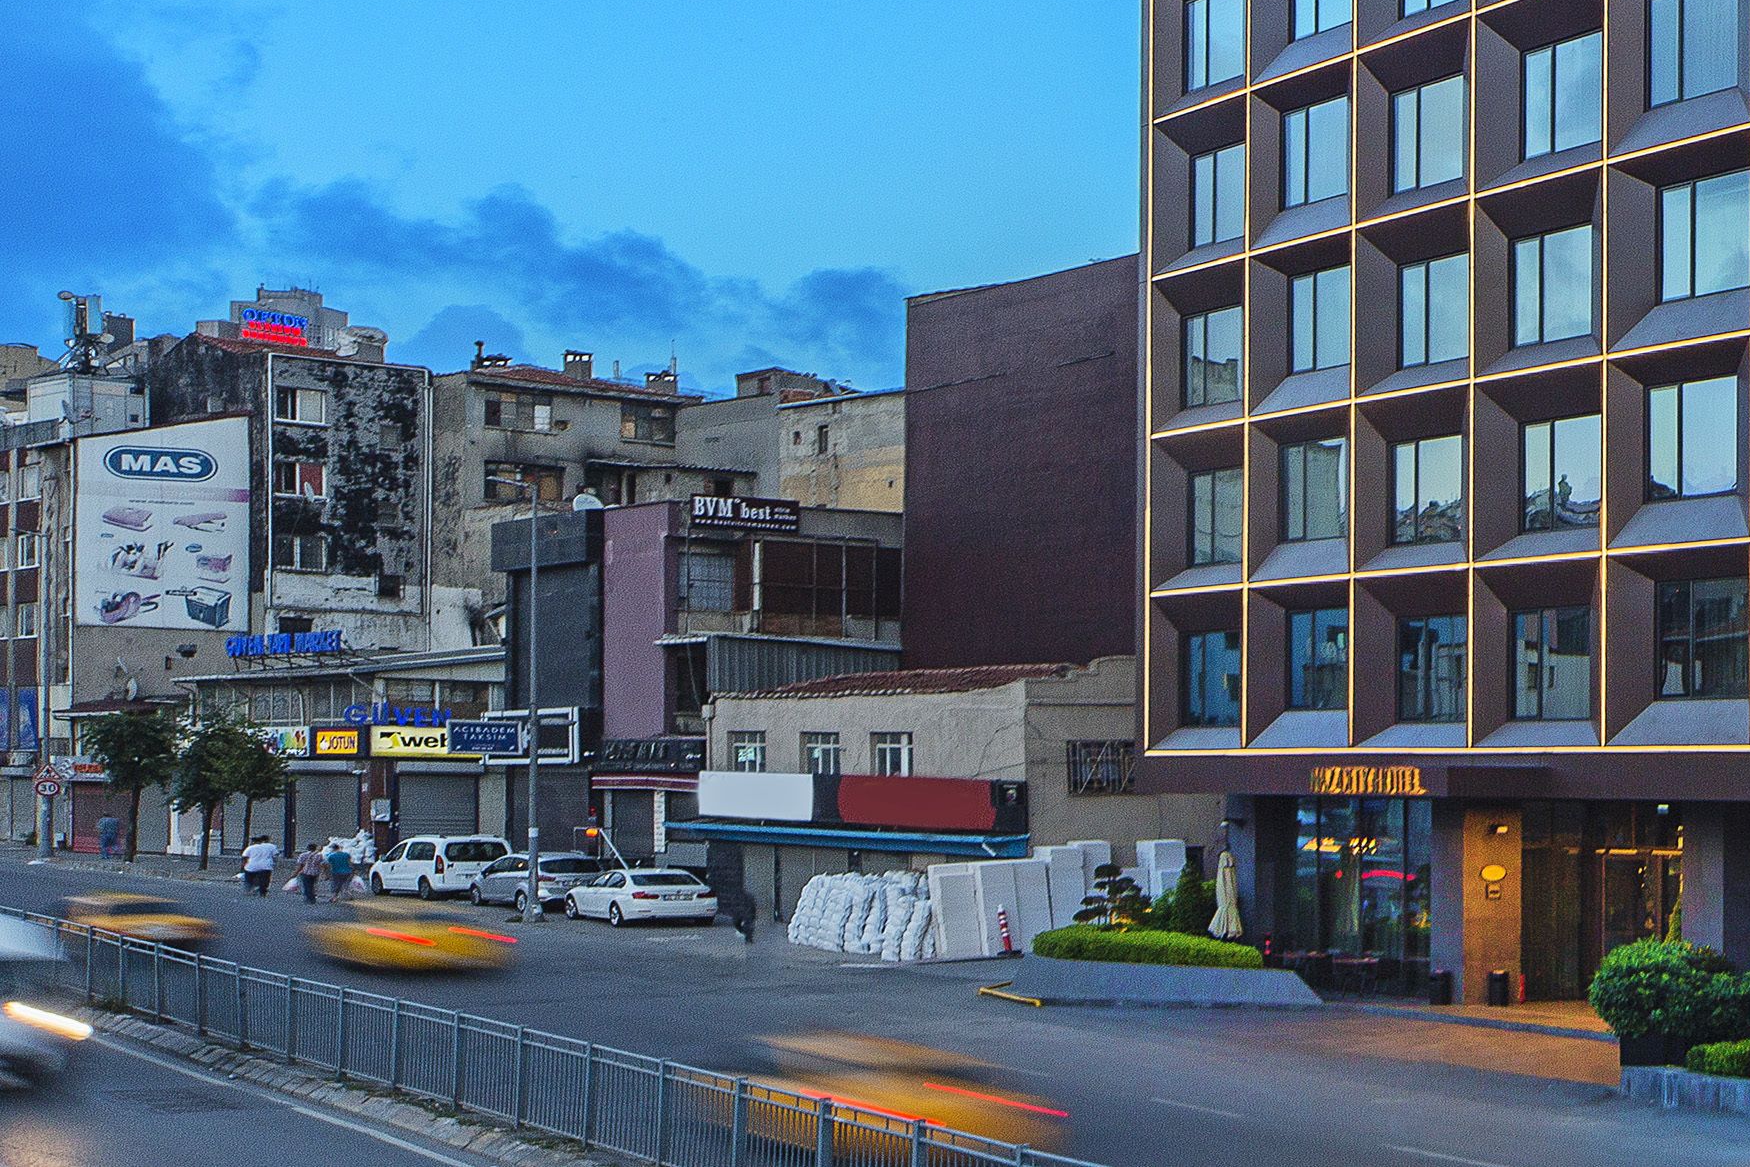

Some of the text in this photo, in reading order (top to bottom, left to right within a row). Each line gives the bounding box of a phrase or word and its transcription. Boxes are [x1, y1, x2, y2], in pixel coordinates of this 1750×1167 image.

[120, 454, 202, 475] MAS
[693, 496, 772, 520] BVM best
[344, 701, 452, 728] GÜVEN
[327, 735, 356, 750] JOTUN
[39, 784, 56, 792] 30
